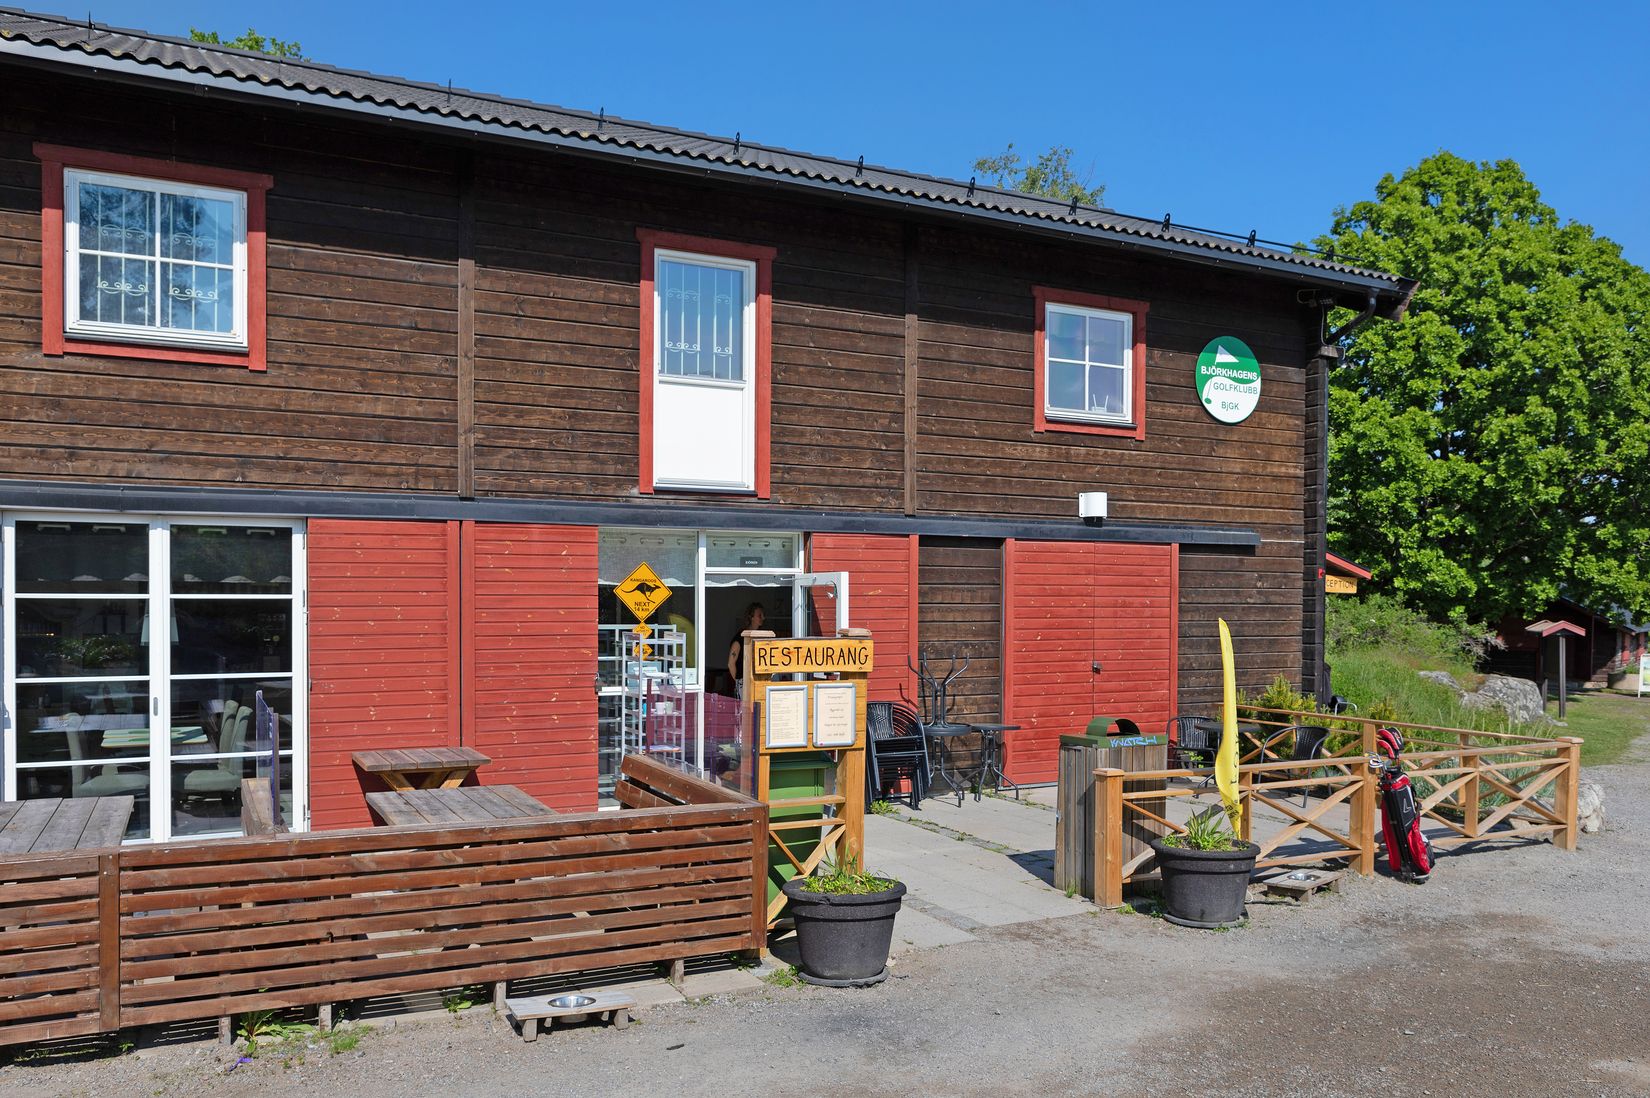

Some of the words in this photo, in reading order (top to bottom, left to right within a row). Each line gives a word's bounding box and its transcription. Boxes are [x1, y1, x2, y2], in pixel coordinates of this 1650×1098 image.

[1201, 366, 1258, 380] BJÖRKHAGENS
[1213, 382, 1258, 394] GOLFKLUBB
[758, 646, 869, 667] RESTAURANG
